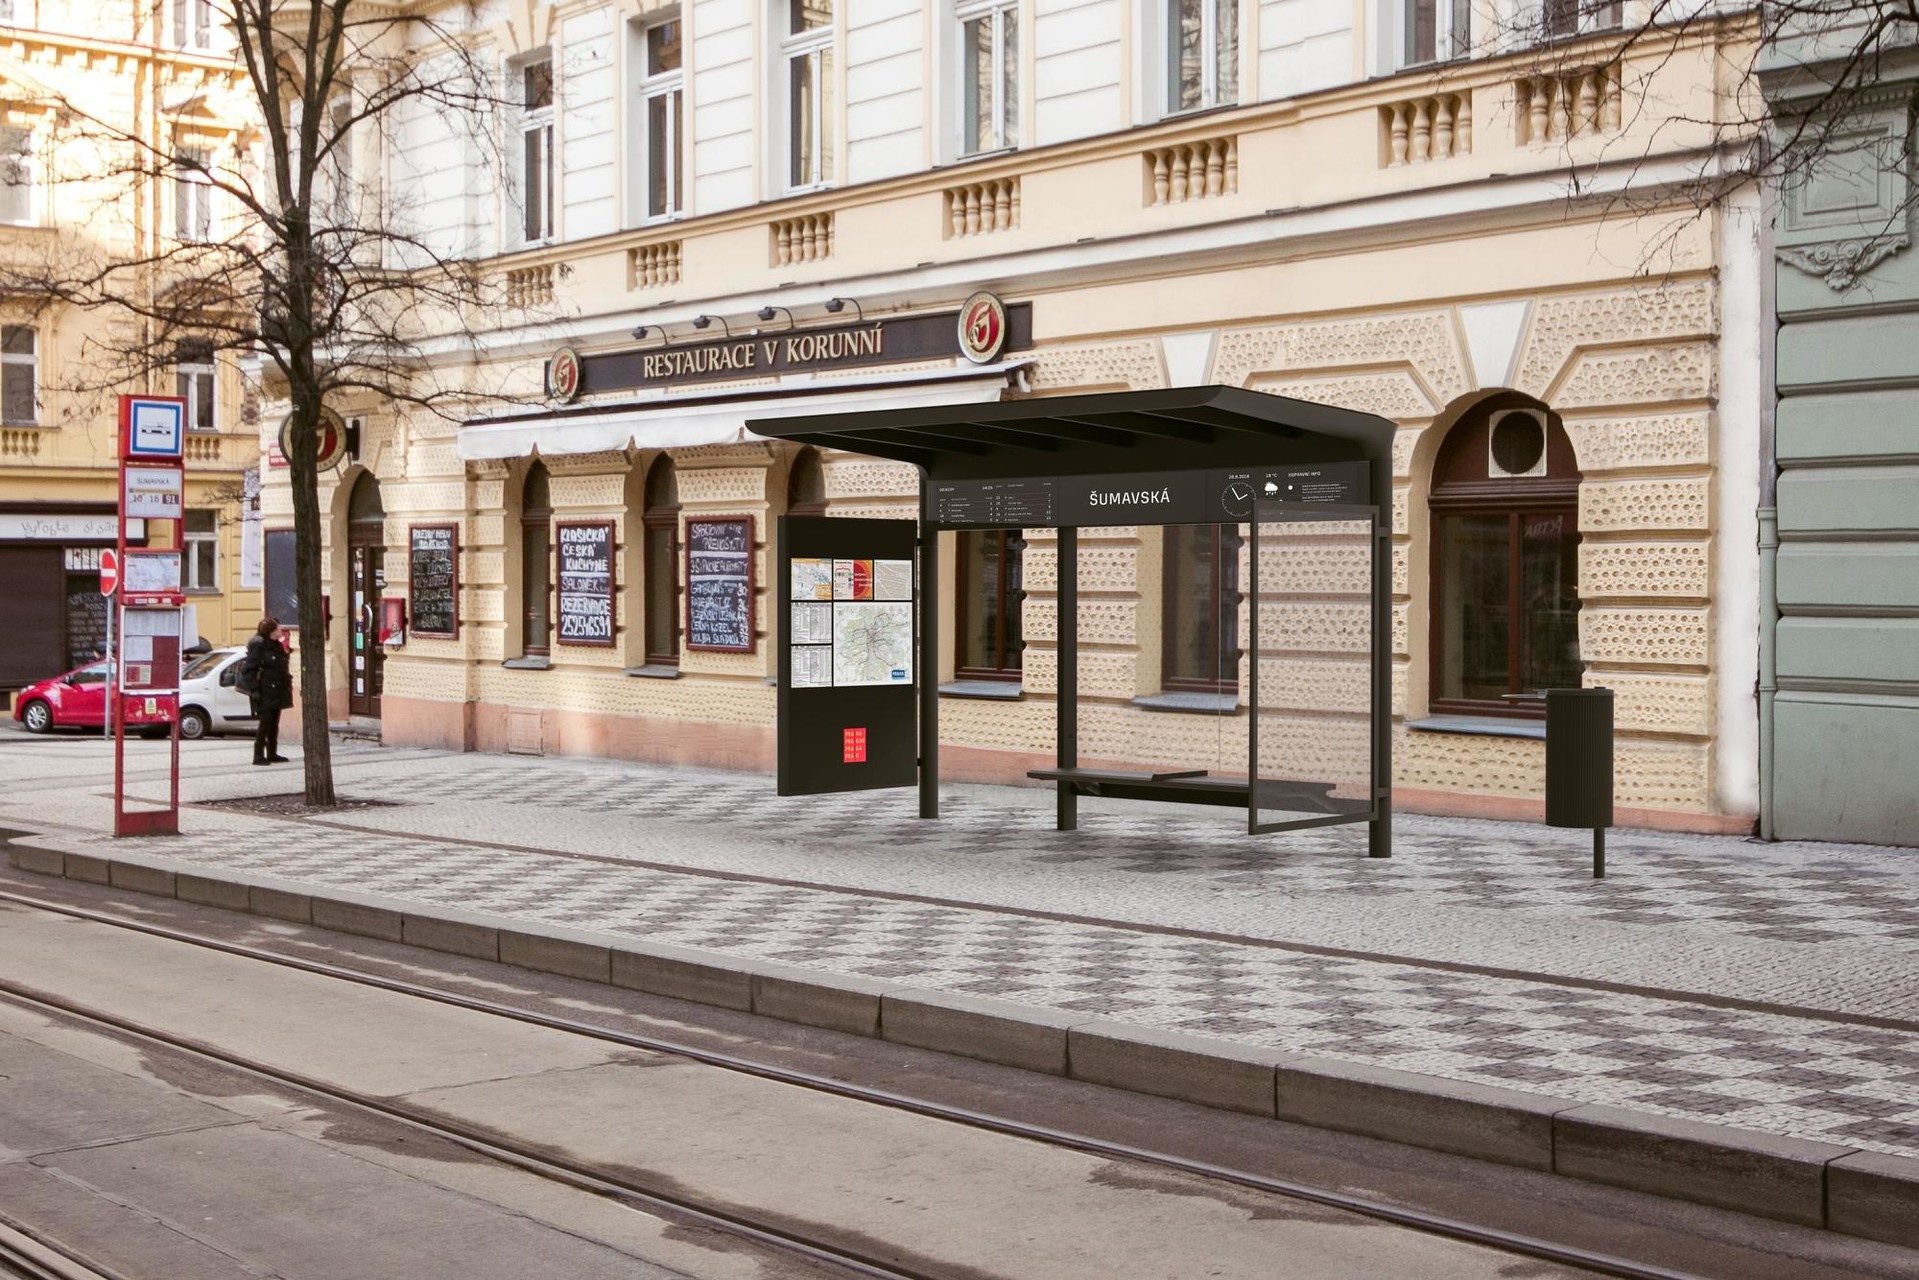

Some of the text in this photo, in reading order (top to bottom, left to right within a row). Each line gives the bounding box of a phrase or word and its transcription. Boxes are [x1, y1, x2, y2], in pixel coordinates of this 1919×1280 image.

[644, 322, 883, 378] RESTAURACE V KORUNNÍ
[133, 494, 177, 504] 10 16 91
[1089, 487, 1170, 506] ŠUMAVSKÁ
[562, 543, 596, 557] ČESKÁ
[562, 577, 599, 592] SALONEK
